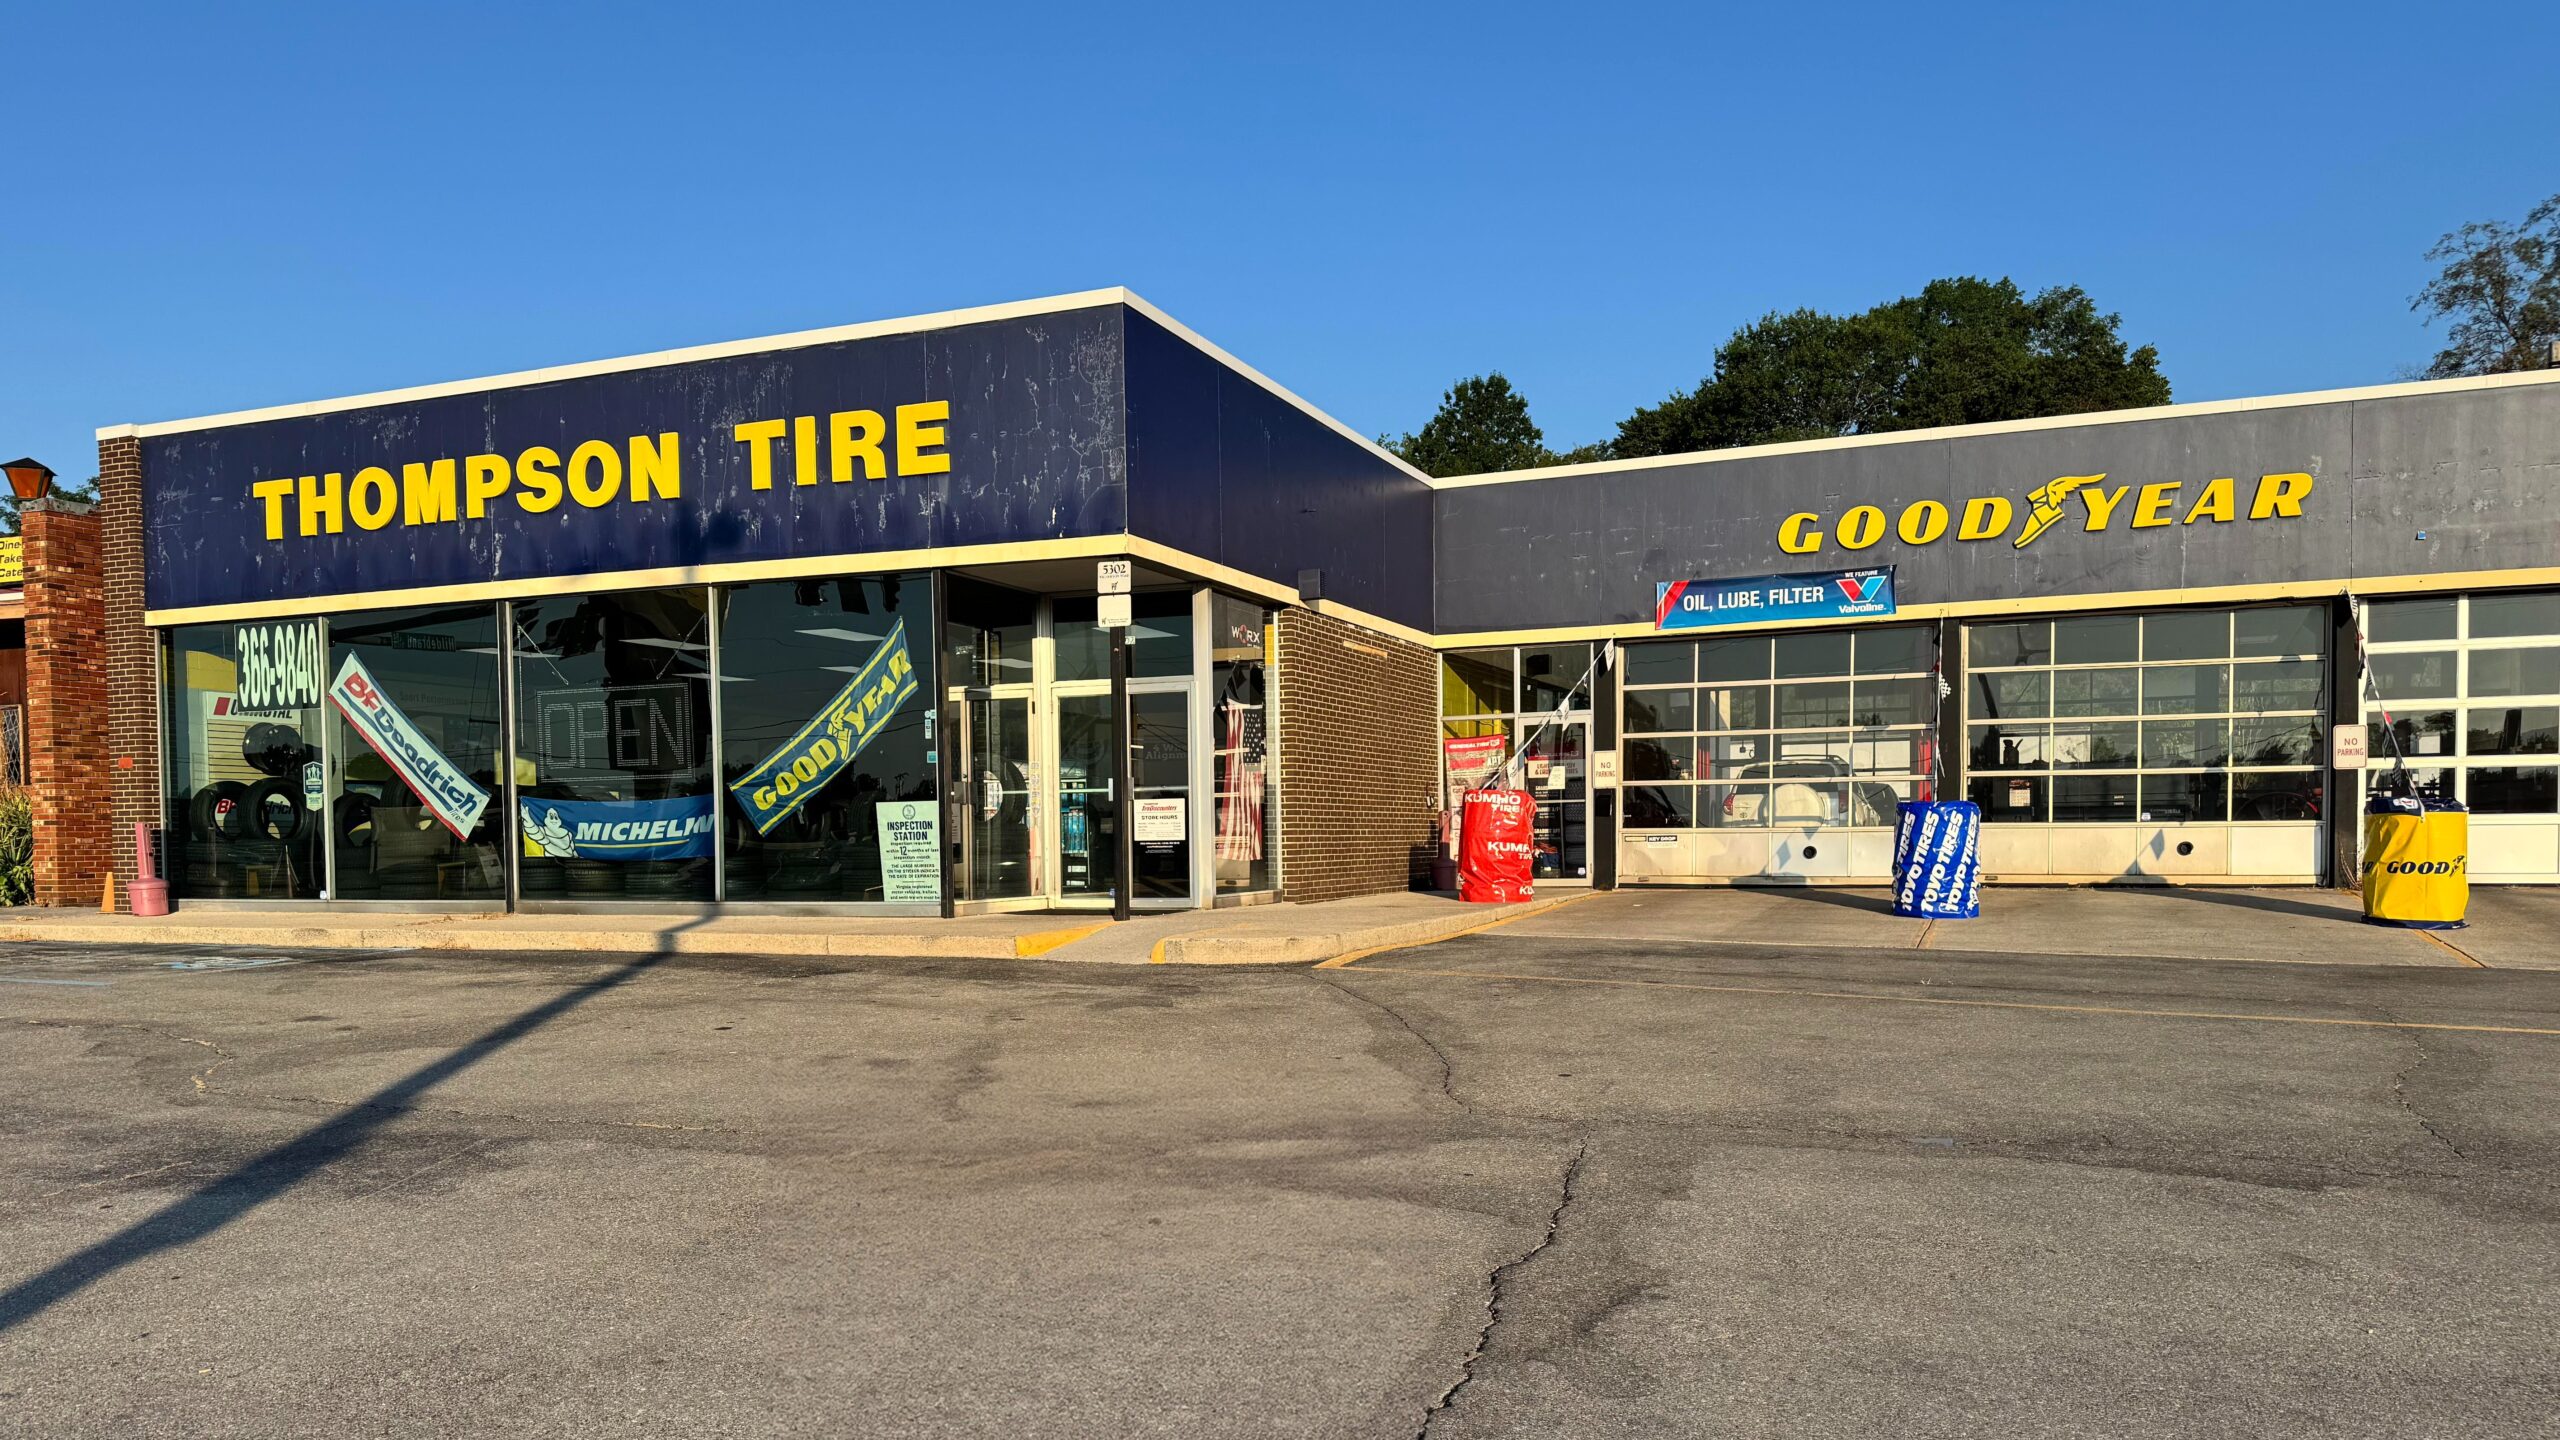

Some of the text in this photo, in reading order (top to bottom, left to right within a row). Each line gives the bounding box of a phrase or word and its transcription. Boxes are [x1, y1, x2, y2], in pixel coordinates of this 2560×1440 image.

[252, 400, 951, 540] THOMPSON TIRE
[1103, 564, 1127, 574] 5302
[1683, 586, 1824, 612] OIL, LUBE, FILTER
[1838, 603, 1884, 614] Valvoline
[238, 622, 319, 708] 366-9840
[344, 671, 478, 817] BFGoodrich
[544, 697, 685, 769] OPEN
[2344, 738, 2358, 746] NO
[2337, 748, 2364, 756] PARKING
[1464, 793, 1521, 805] KUMHO
[1491, 803, 1520, 813] TIRE
[575, 813, 714, 841] MICHELIN
[887, 821, 933, 831] INSPECTION
[894, 831, 928, 841] STATION
[1897, 810, 1916, 864] TIRES
[1913, 810, 1940, 865] TIRES
[1961, 811, 1978, 865] TIRES
[900, 846, 907, 856] 12
[1921, 810, 1964, 913] TOYO TIRES
